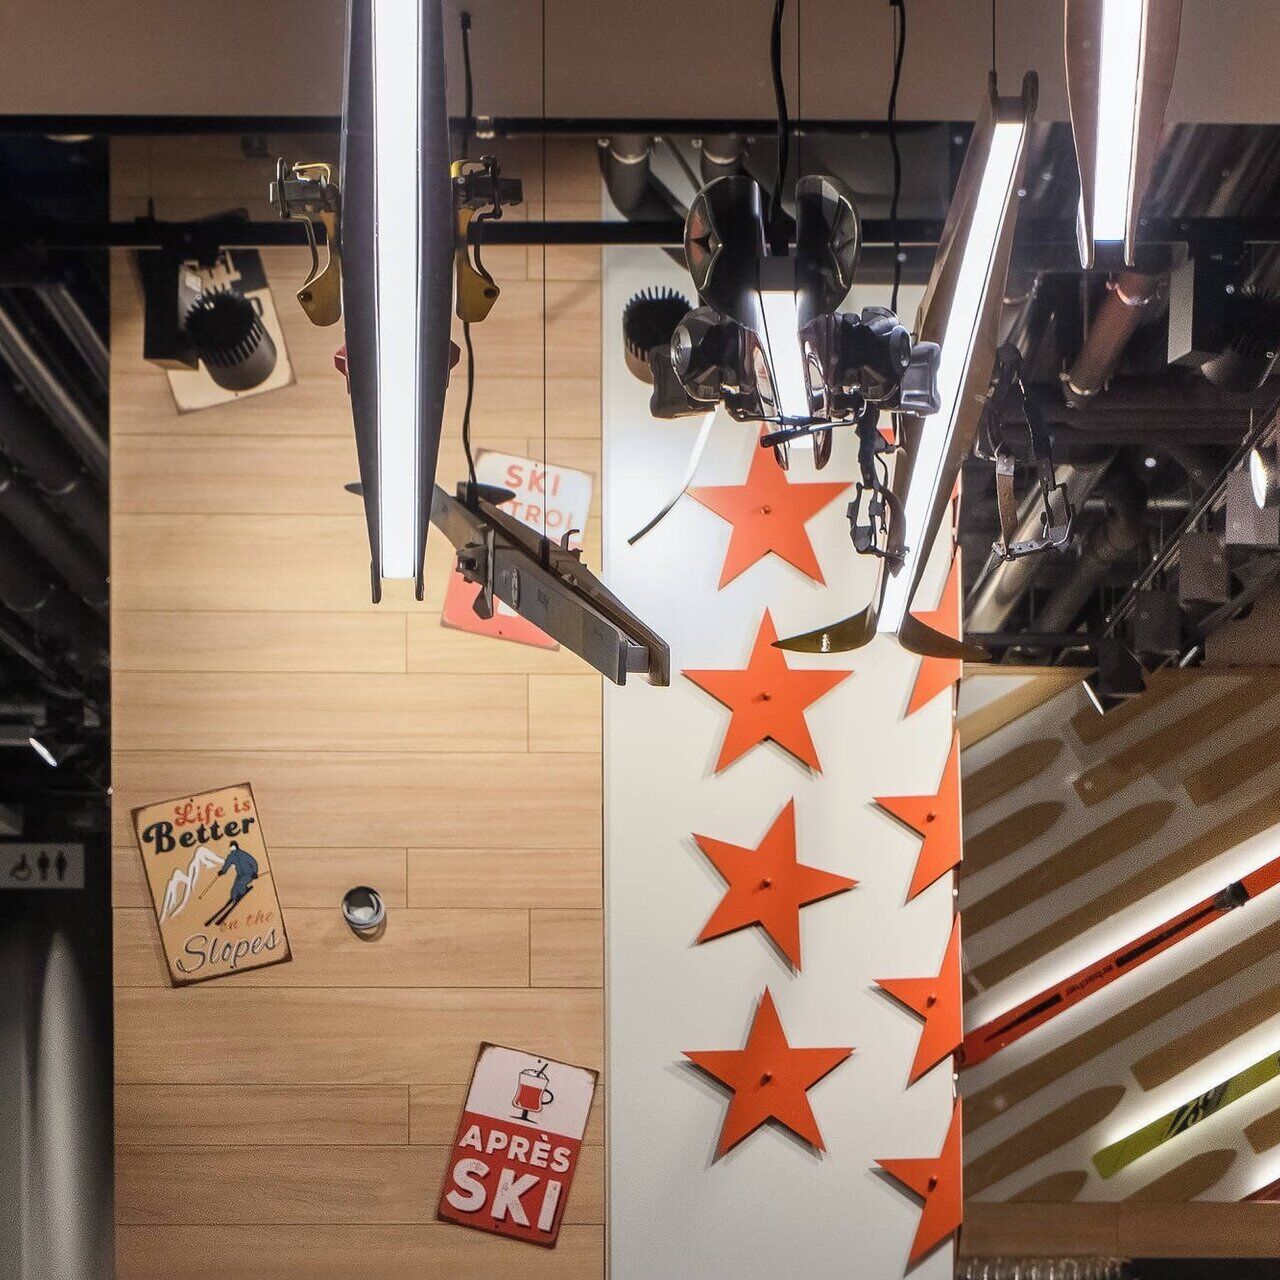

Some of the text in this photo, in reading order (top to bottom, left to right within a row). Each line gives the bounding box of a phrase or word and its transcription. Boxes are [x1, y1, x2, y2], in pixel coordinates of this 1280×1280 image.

[505, 464, 560, 496] SKI
[174, 797, 251, 827] Life is
[142, 816, 254, 854] Better
[176, 929, 278, 973] Slopes
[458, 1125, 571, 1173] APRÈS
[446, 1158, 562, 1232] SKI
